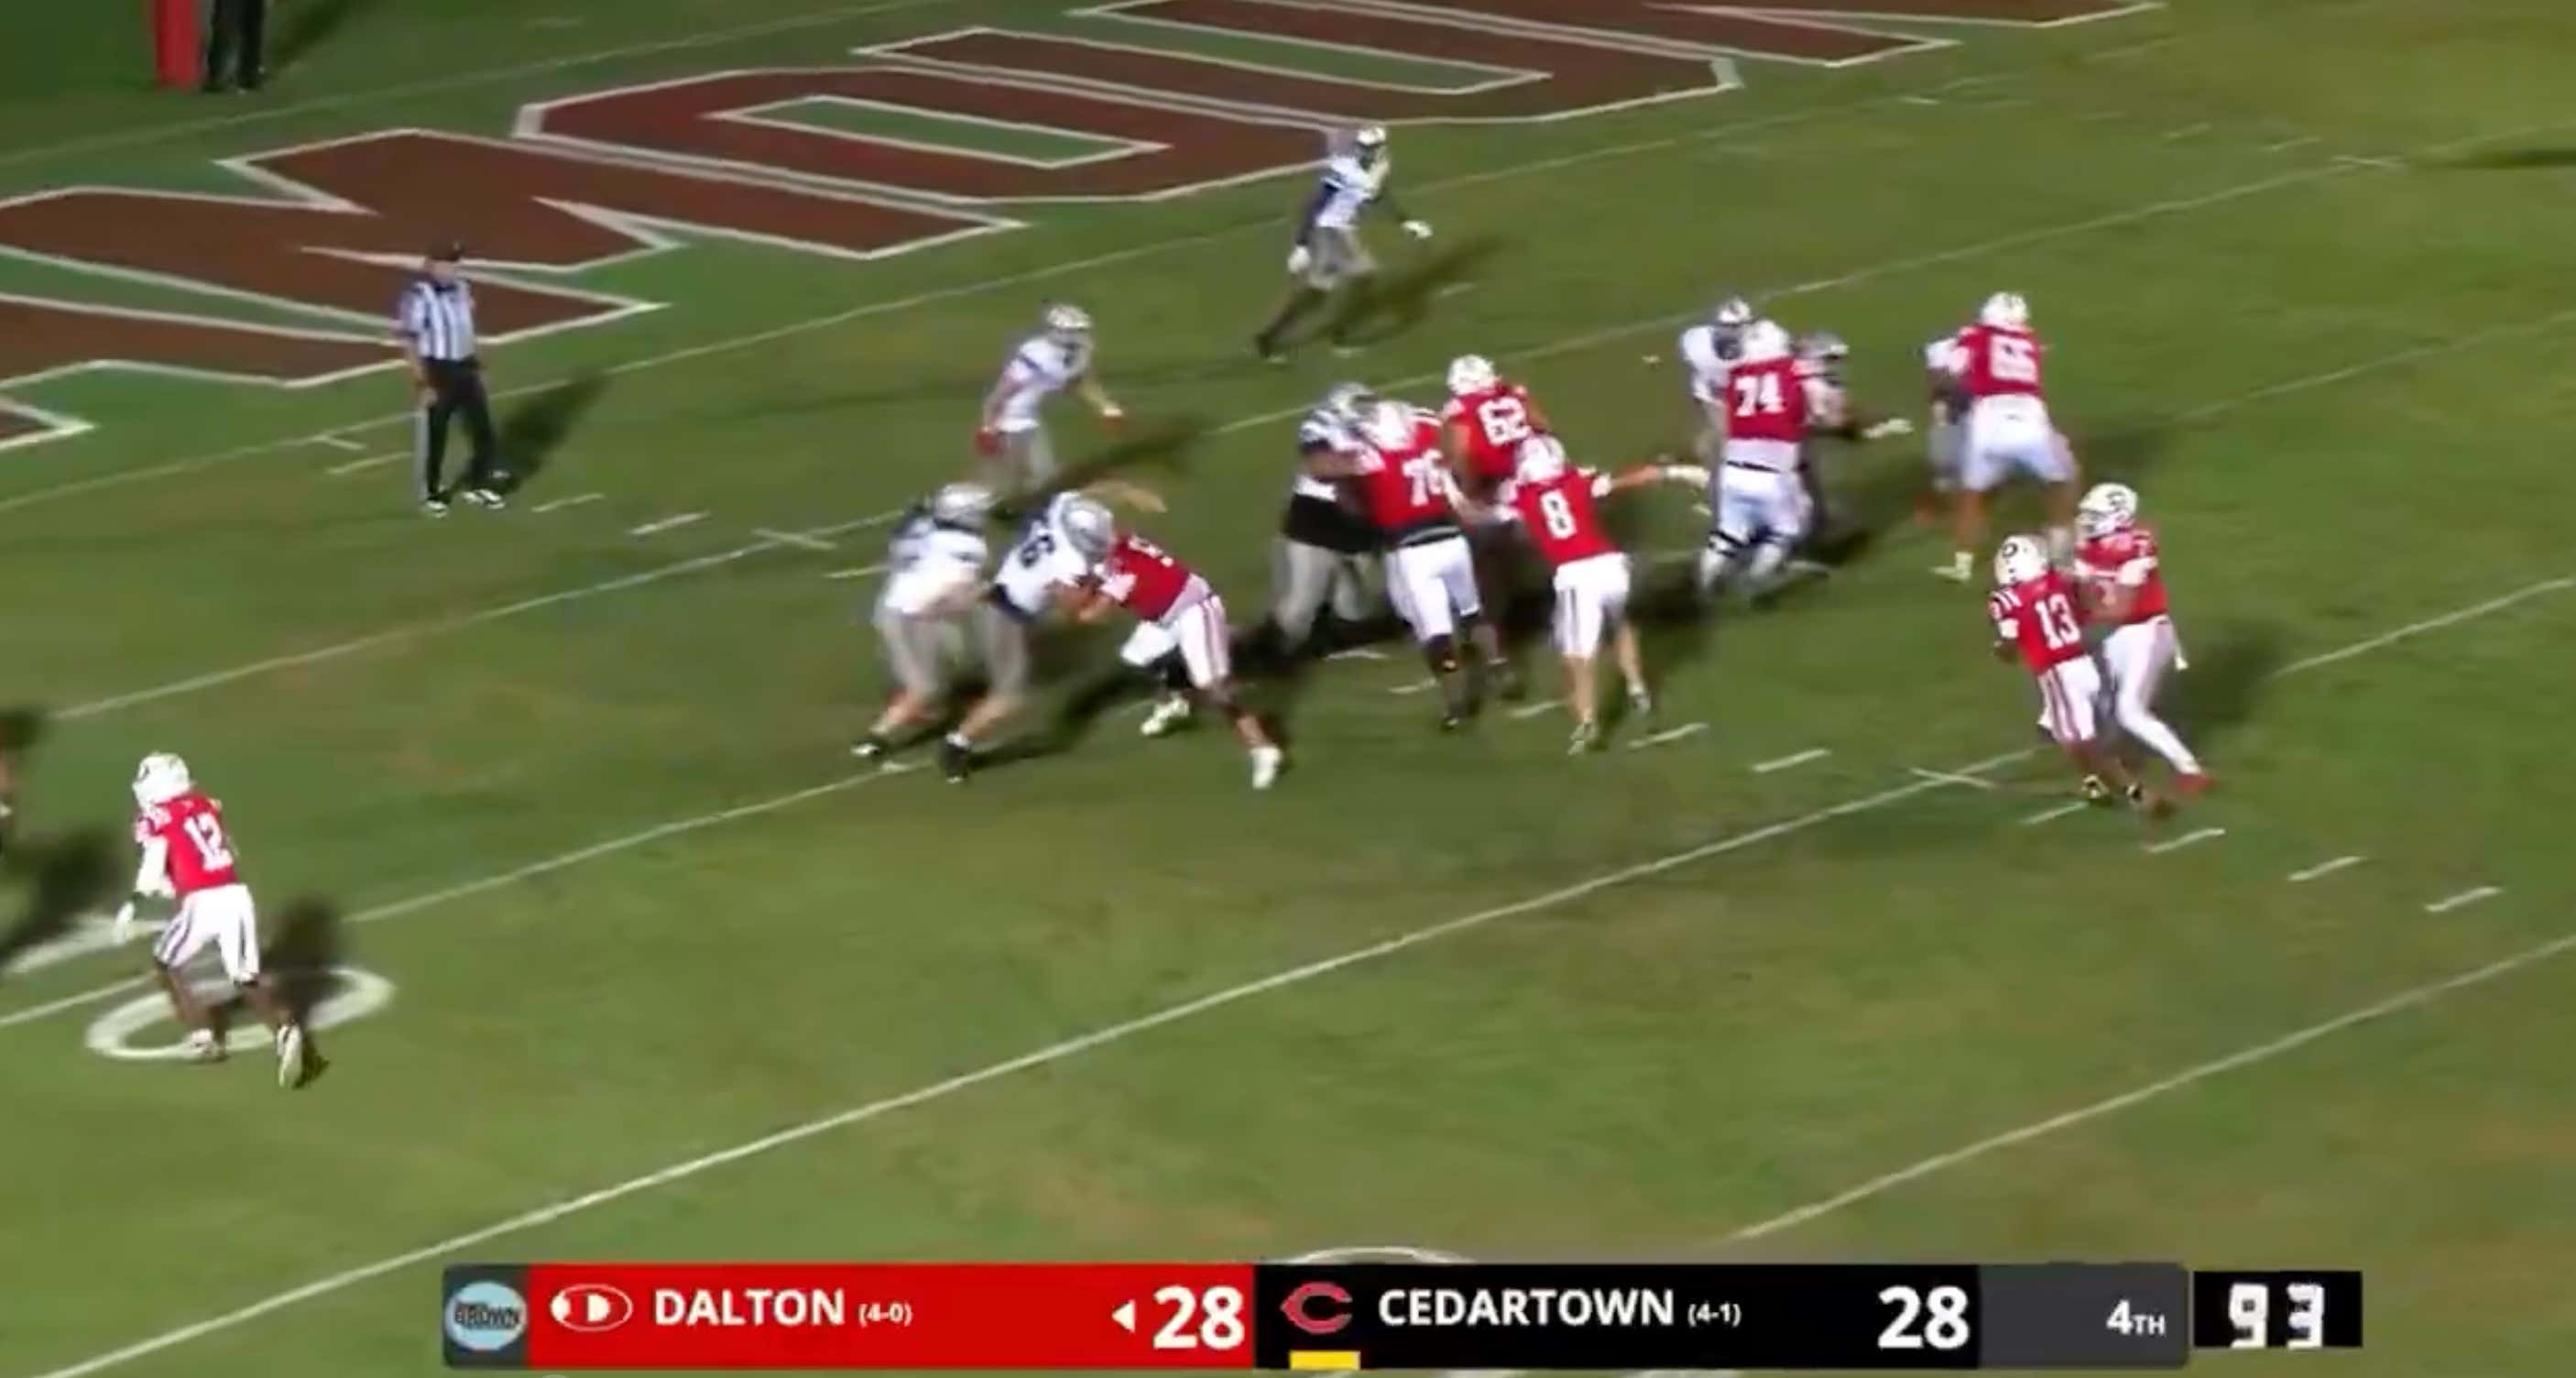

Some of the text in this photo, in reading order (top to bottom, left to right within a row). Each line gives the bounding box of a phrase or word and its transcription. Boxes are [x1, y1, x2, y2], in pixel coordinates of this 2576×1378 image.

[1733, 372, 1784, 416] 74
[1477, 395, 1534, 446] 62
[1539, 488, 1576, 540] 8
[2034, 593, 2080, 651] 13
[183, 812, 235, 872] 12
